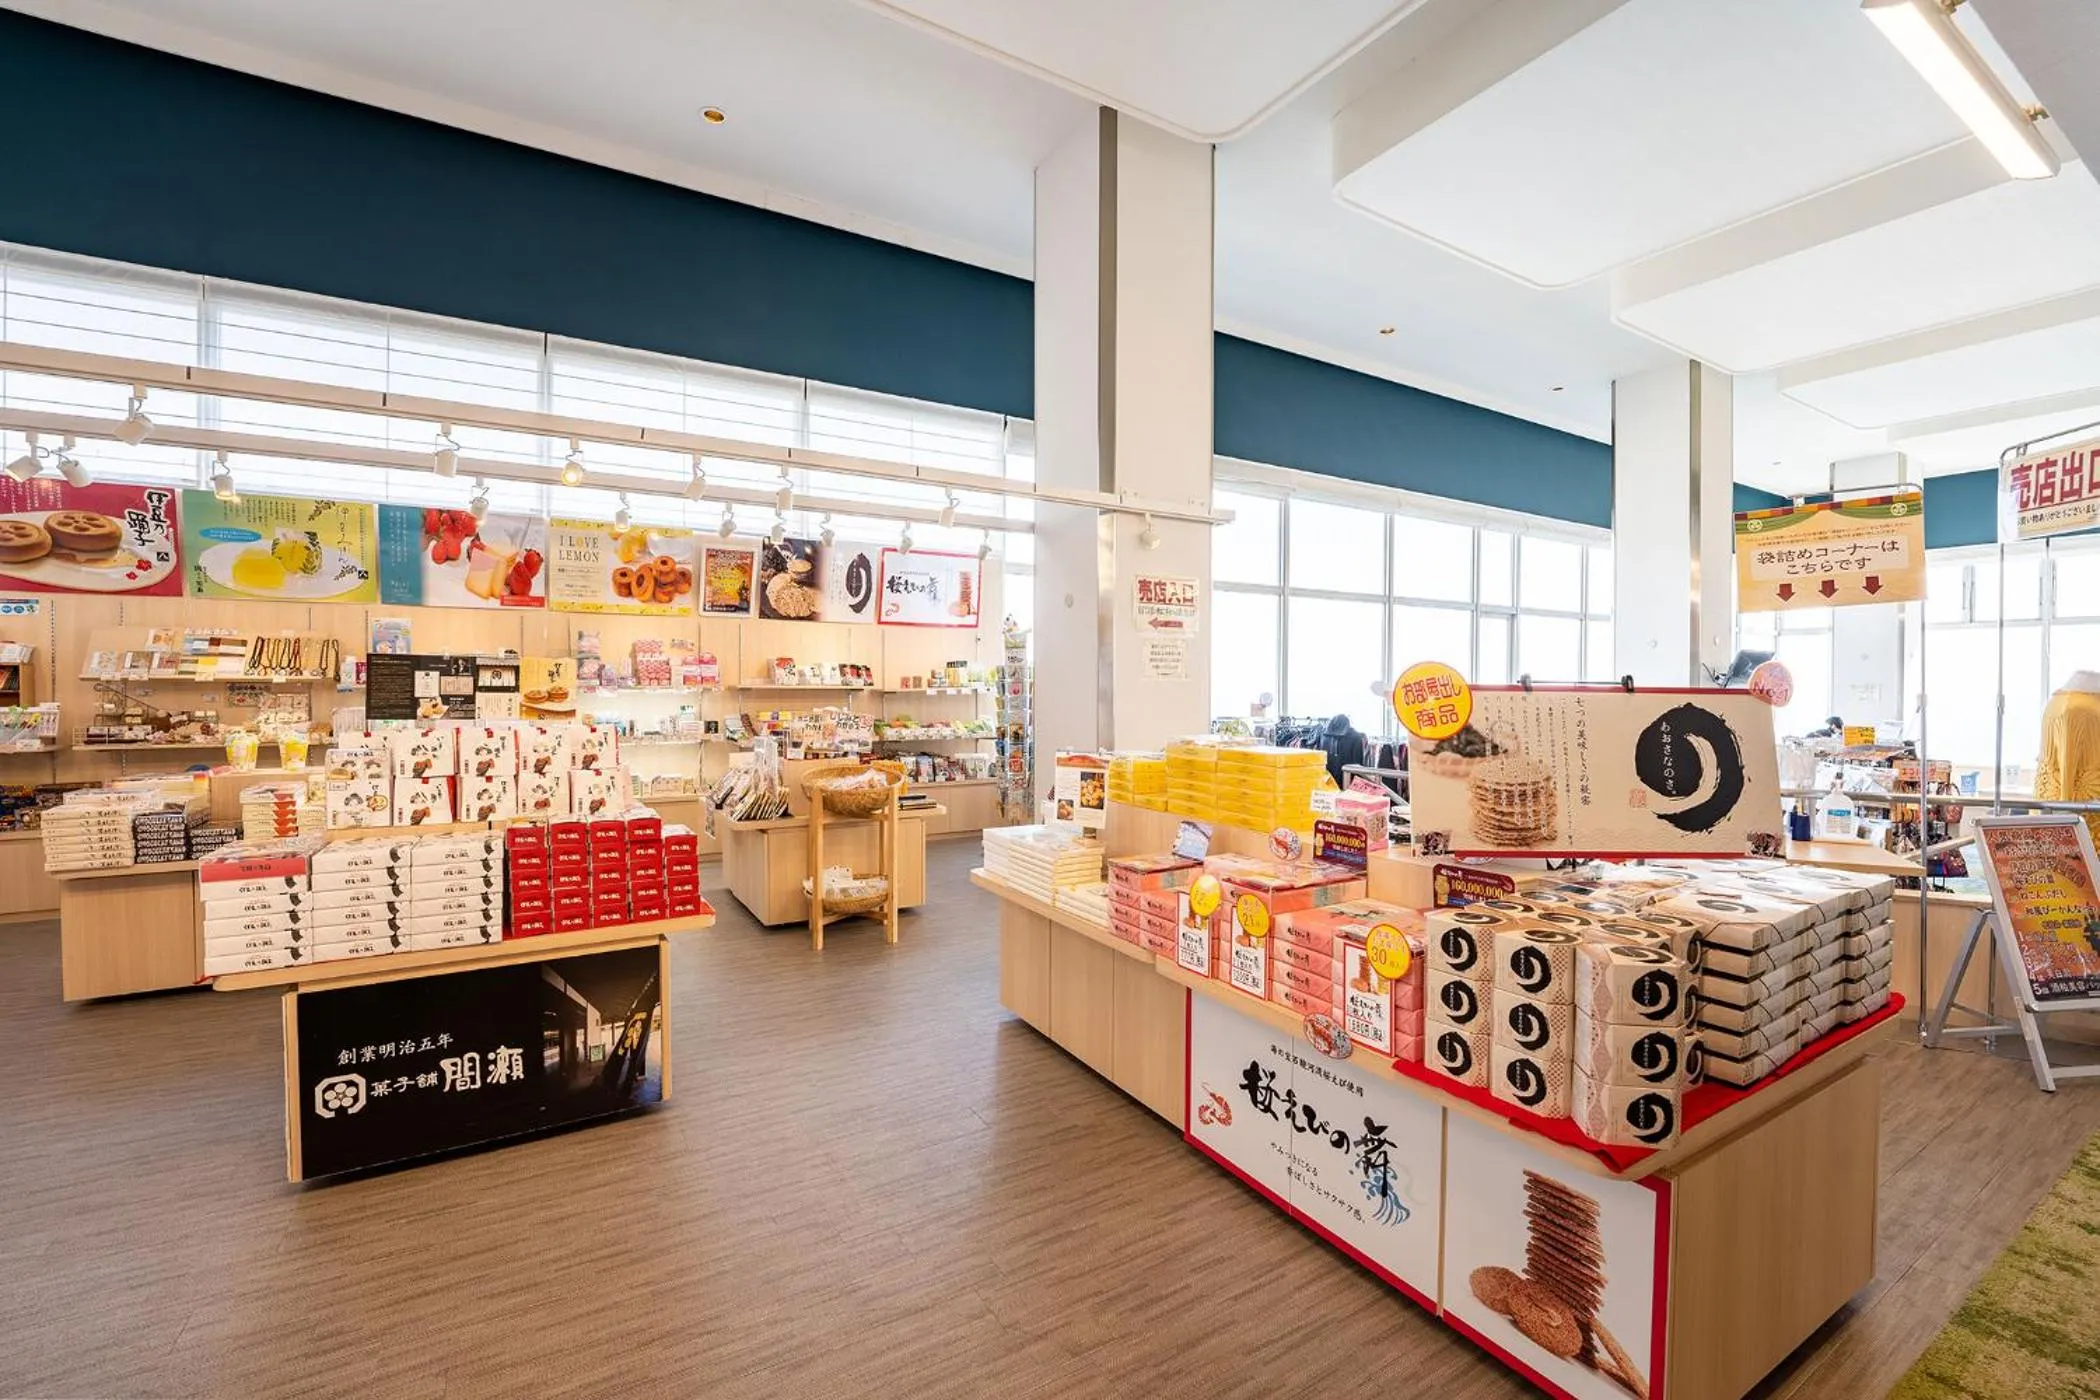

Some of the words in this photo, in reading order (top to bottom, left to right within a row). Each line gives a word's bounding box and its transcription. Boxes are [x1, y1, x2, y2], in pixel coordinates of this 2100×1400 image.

[559, 535, 565, 547] I
[569, 535, 599, 549] LOVE
[1757, 540, 1900, 565] 袋詰めコーナーは
[558, 550, 599, 562] LEMON
[1786, 556, 1872, 575] こちらです
[1138, 579, 1195, 604] 売店入口
[1402, 674, 1462, 706] お部屋出し
[1415, 704, 1459, 730] 商品
[337, 1033, 454, 1066] 創業明治五年
[1238, 1059, 1398, 1199] 桜えびの舞
